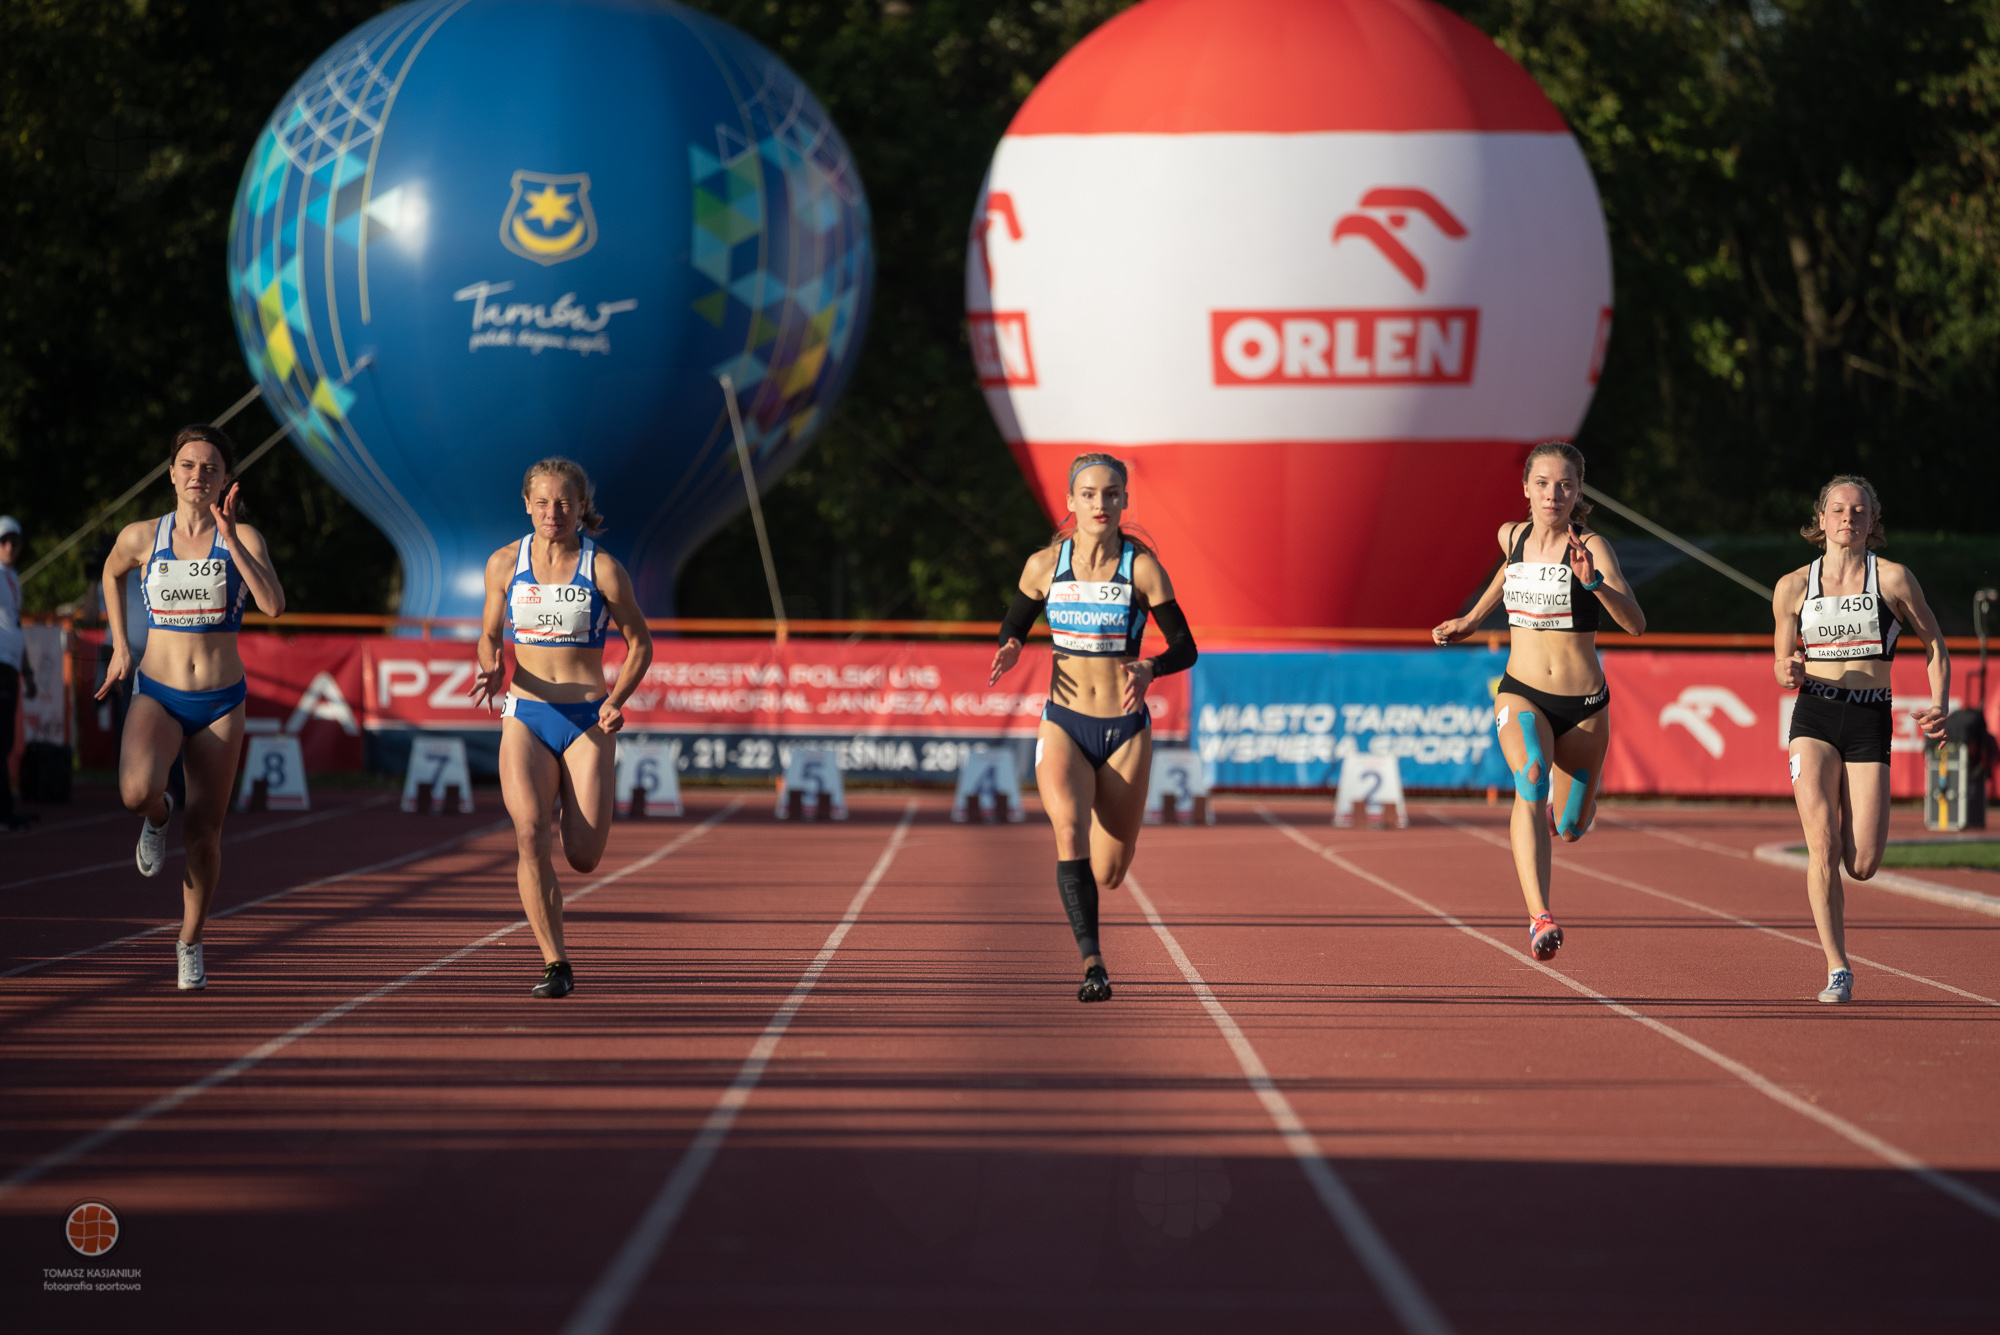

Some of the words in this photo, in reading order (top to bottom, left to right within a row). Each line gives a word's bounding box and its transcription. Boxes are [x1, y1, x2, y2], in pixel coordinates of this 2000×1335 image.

[1221, 317, 1467, 380] ORLEN
[189, 562, 222, 577] 369
[1538, 567, 1568, 583] 192
[160, 588, 211, 601] GAWEŁ
[555, 587, 587, 602] 105
[1099, 586, 1121, 601] 59
[1841, 596, 1874, 612] 450
[160, 616, 194, 625] TARNÓW
[197, 616, 216, 624] 2019
[538, 611, 563, 626] SEŃ
[1049, 610, 1126, 626] PIOTROWSKA
[1818, 623, 1862, 637] DURAJ
[1096, 642, 1114, 650] 2019
[1852, 647, 1870, 655] 2019
[789, 664, 887, 689] POLSKI
[890, 665, 941, 690] U16
[1801, 678, 1838, 700] PRO
[816, 690, 949, 715] JANUSZA
[1584, 690, 1605, 705] NIKE
[1199, 703, 1336, 734] MIASTO
[1199, 733, 1357, 763] WSPIERA
[1368, 735, 1492, 765] SPORT
[264, 752, 285, 788] 8
[425, 754, 450, 792] 7
[635, 758, 660, 796] 6
[802, 760, 826, 797] 5
[1167, 766, 1191, 803] 3
[1360, 771, 1383, 807] 2
